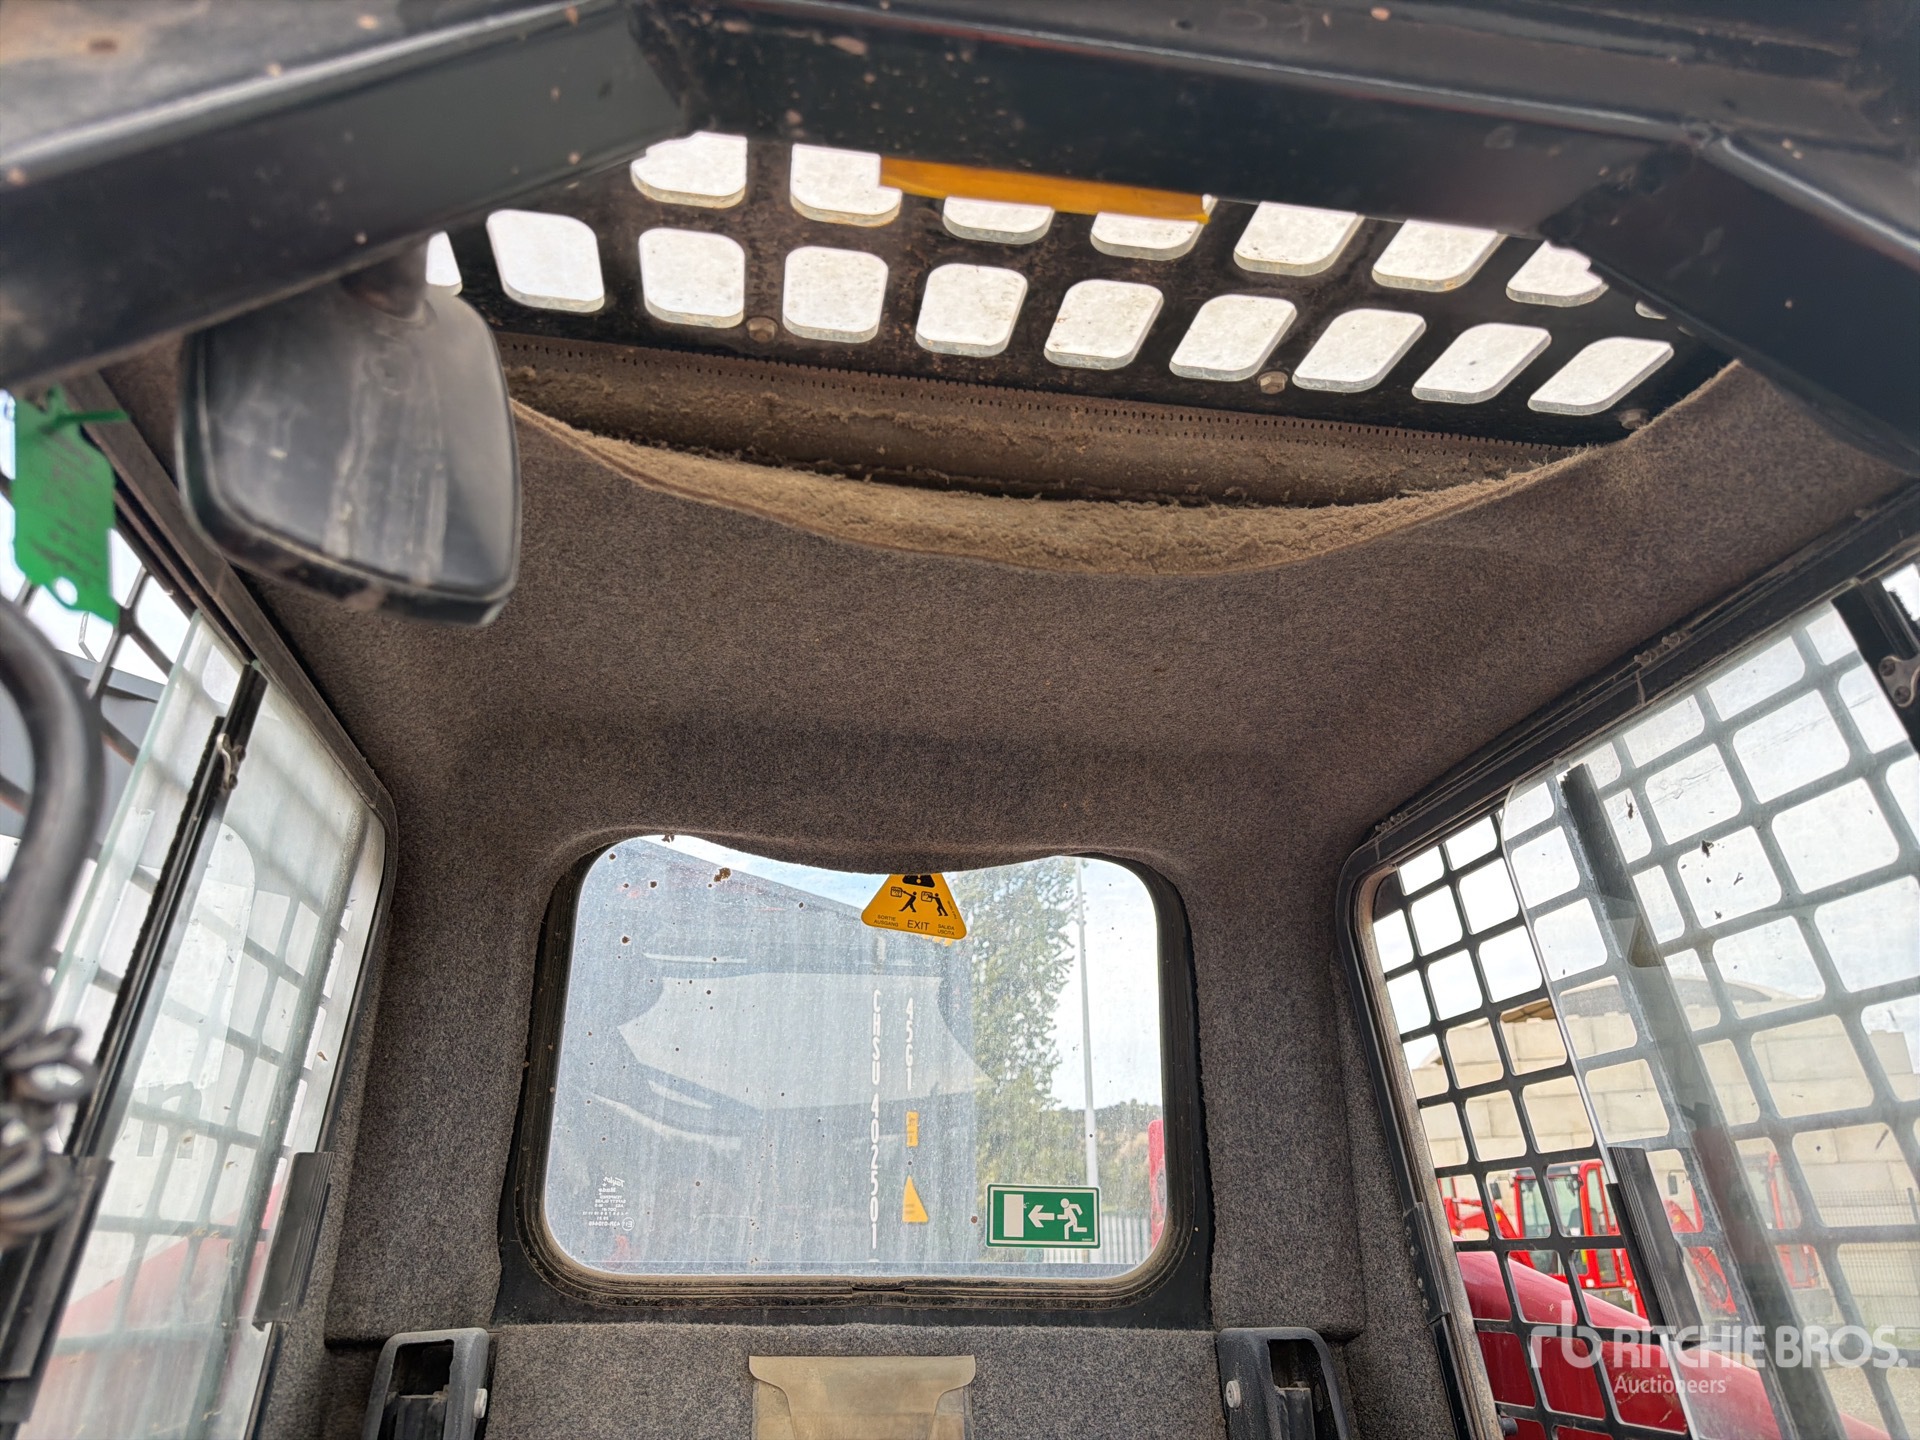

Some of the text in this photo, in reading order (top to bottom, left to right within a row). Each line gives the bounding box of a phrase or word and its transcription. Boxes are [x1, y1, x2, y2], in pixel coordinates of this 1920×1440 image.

[907, 919, 930, 931] EXIT
[905, 997, 914, 1092] 45G1
[869, 989, 881, 1250] CHSU 402501
